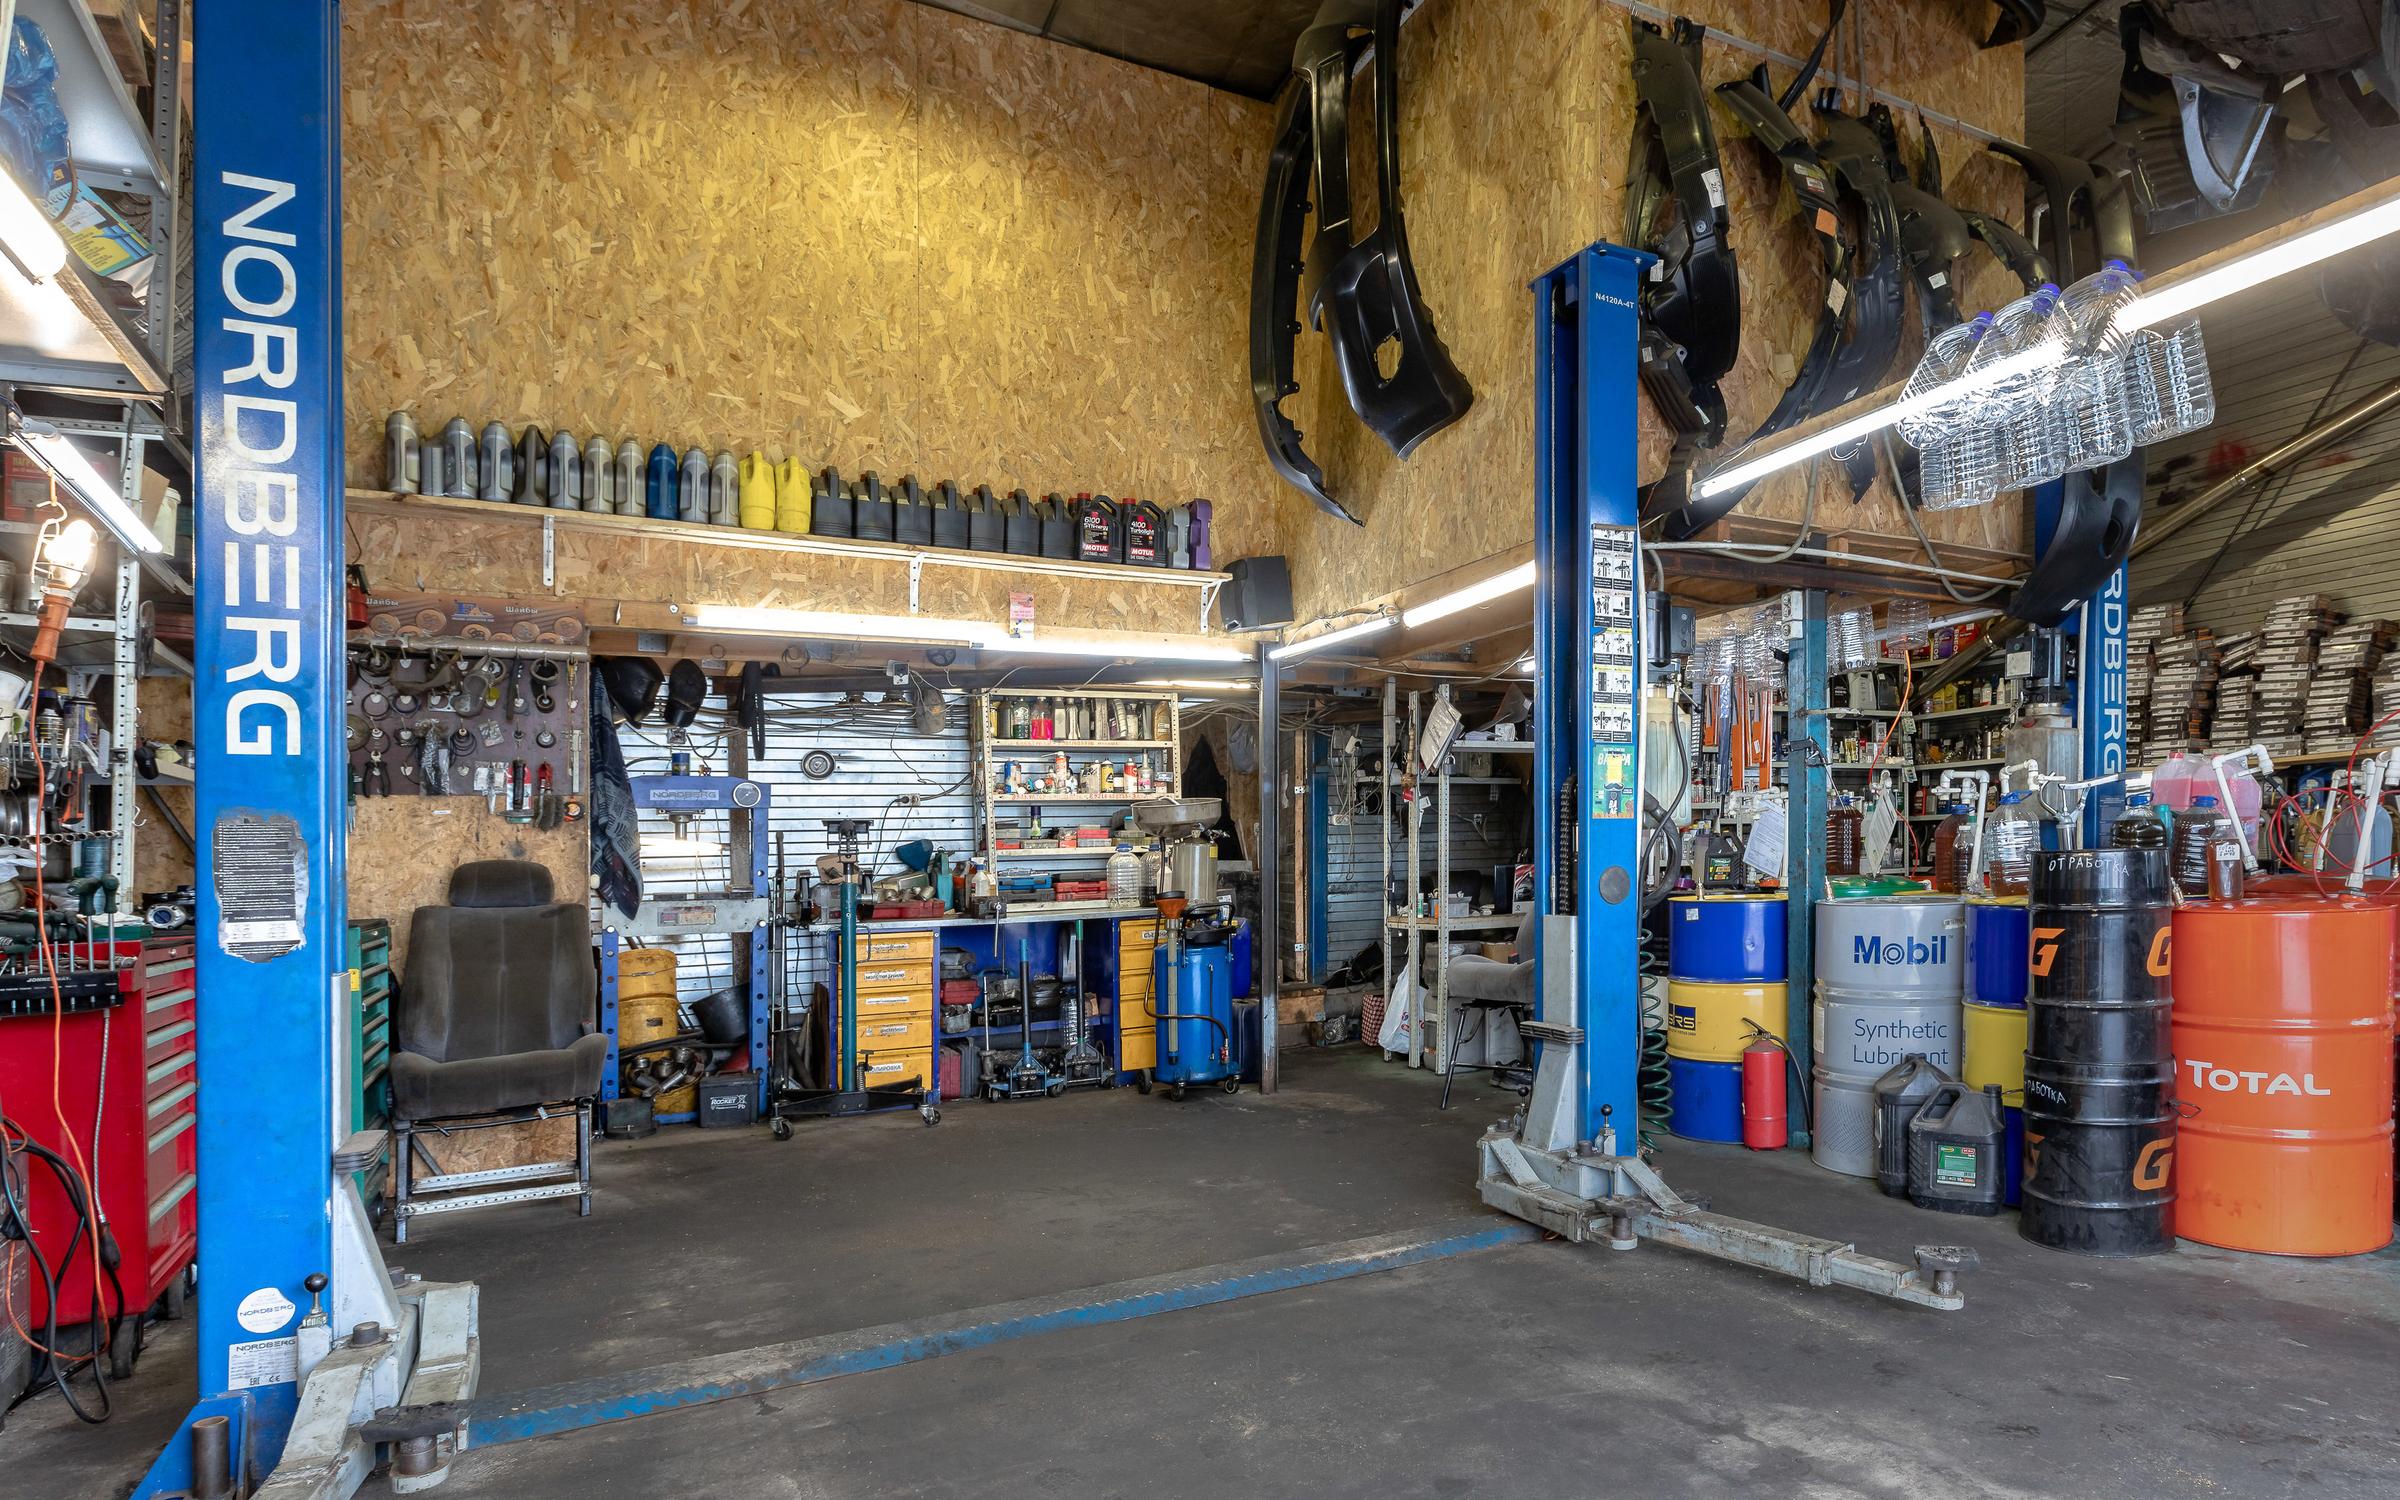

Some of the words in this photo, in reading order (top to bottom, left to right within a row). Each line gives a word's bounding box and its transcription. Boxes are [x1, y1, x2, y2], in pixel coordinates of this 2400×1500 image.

[1595, 292, 1635, 309] N4120A-4T
[222, 170, 301, 757] NORDBERG
[1085, 544, 1108, 552] MOTUL
[505, 605, 538, 615] Шайбы
[652, 791, 717, 799] NORDBERG
[1853, 935, 1947, 965] Mobil
[1854, 1018, 1948, 1043] Synthetic
[1853, 1044, 1949, 1065] Lubrint
[2185, 1059, 2331, 1096] TOTAL
[239, 1304, 295, 1317] NORDBERG
[236, 1340, 296, 1352] NORDBERG
